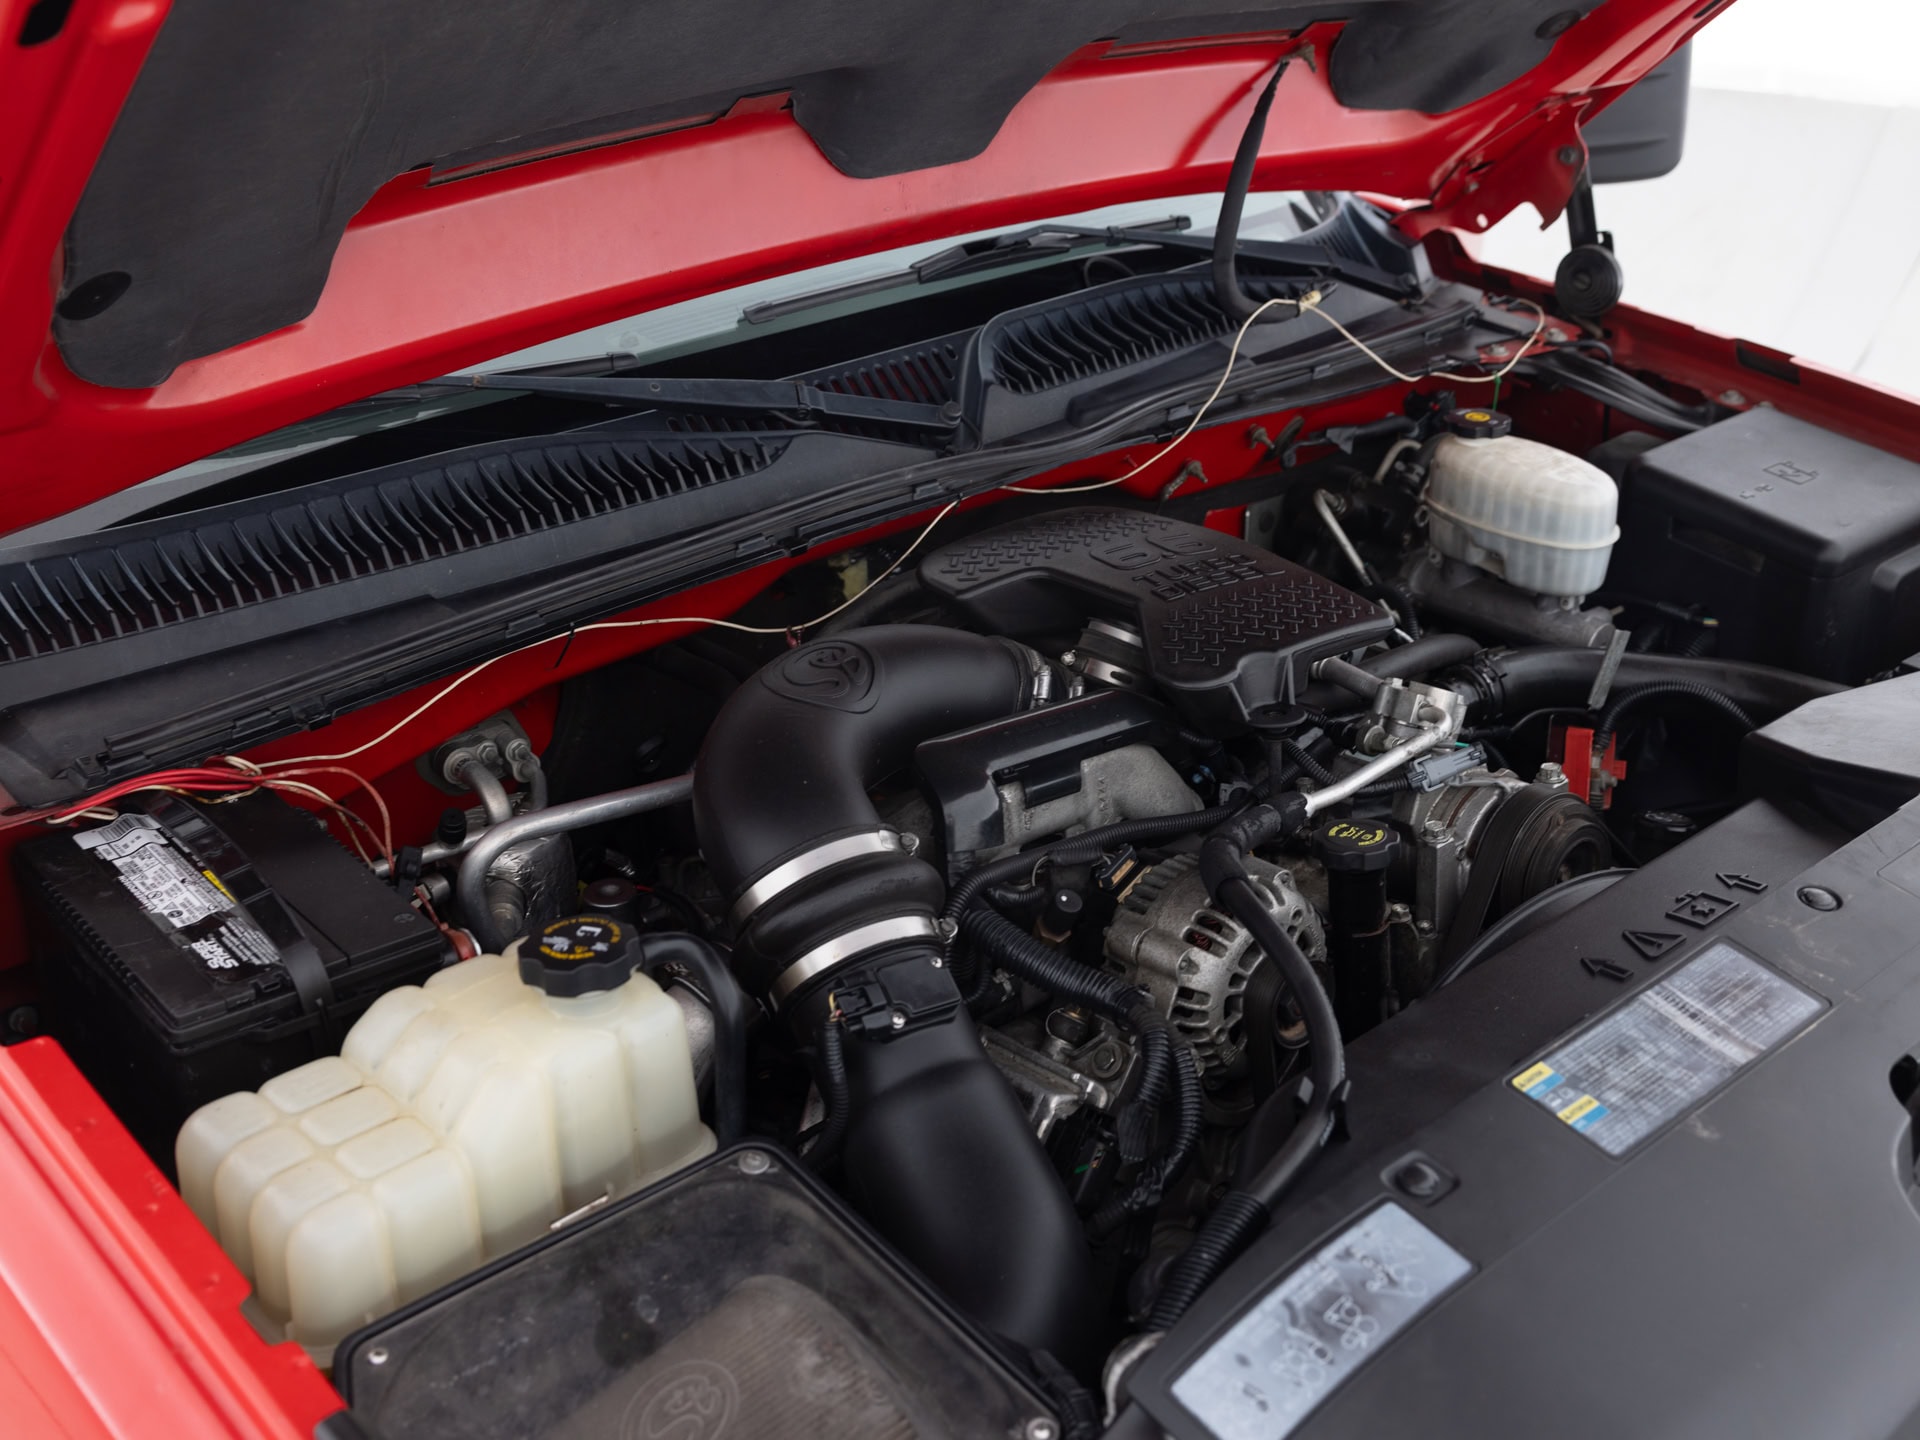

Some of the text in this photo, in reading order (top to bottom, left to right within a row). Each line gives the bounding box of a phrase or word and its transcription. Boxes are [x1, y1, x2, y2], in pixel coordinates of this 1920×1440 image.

[1089, 531, 1217, 571] 6.6
[1132, 554, 1257, 588] TURBO
[1150, 566, 1286, 602] DIESEL
[191, 941, 220, 969] SUPER
[200, 938, 240, 969] START
